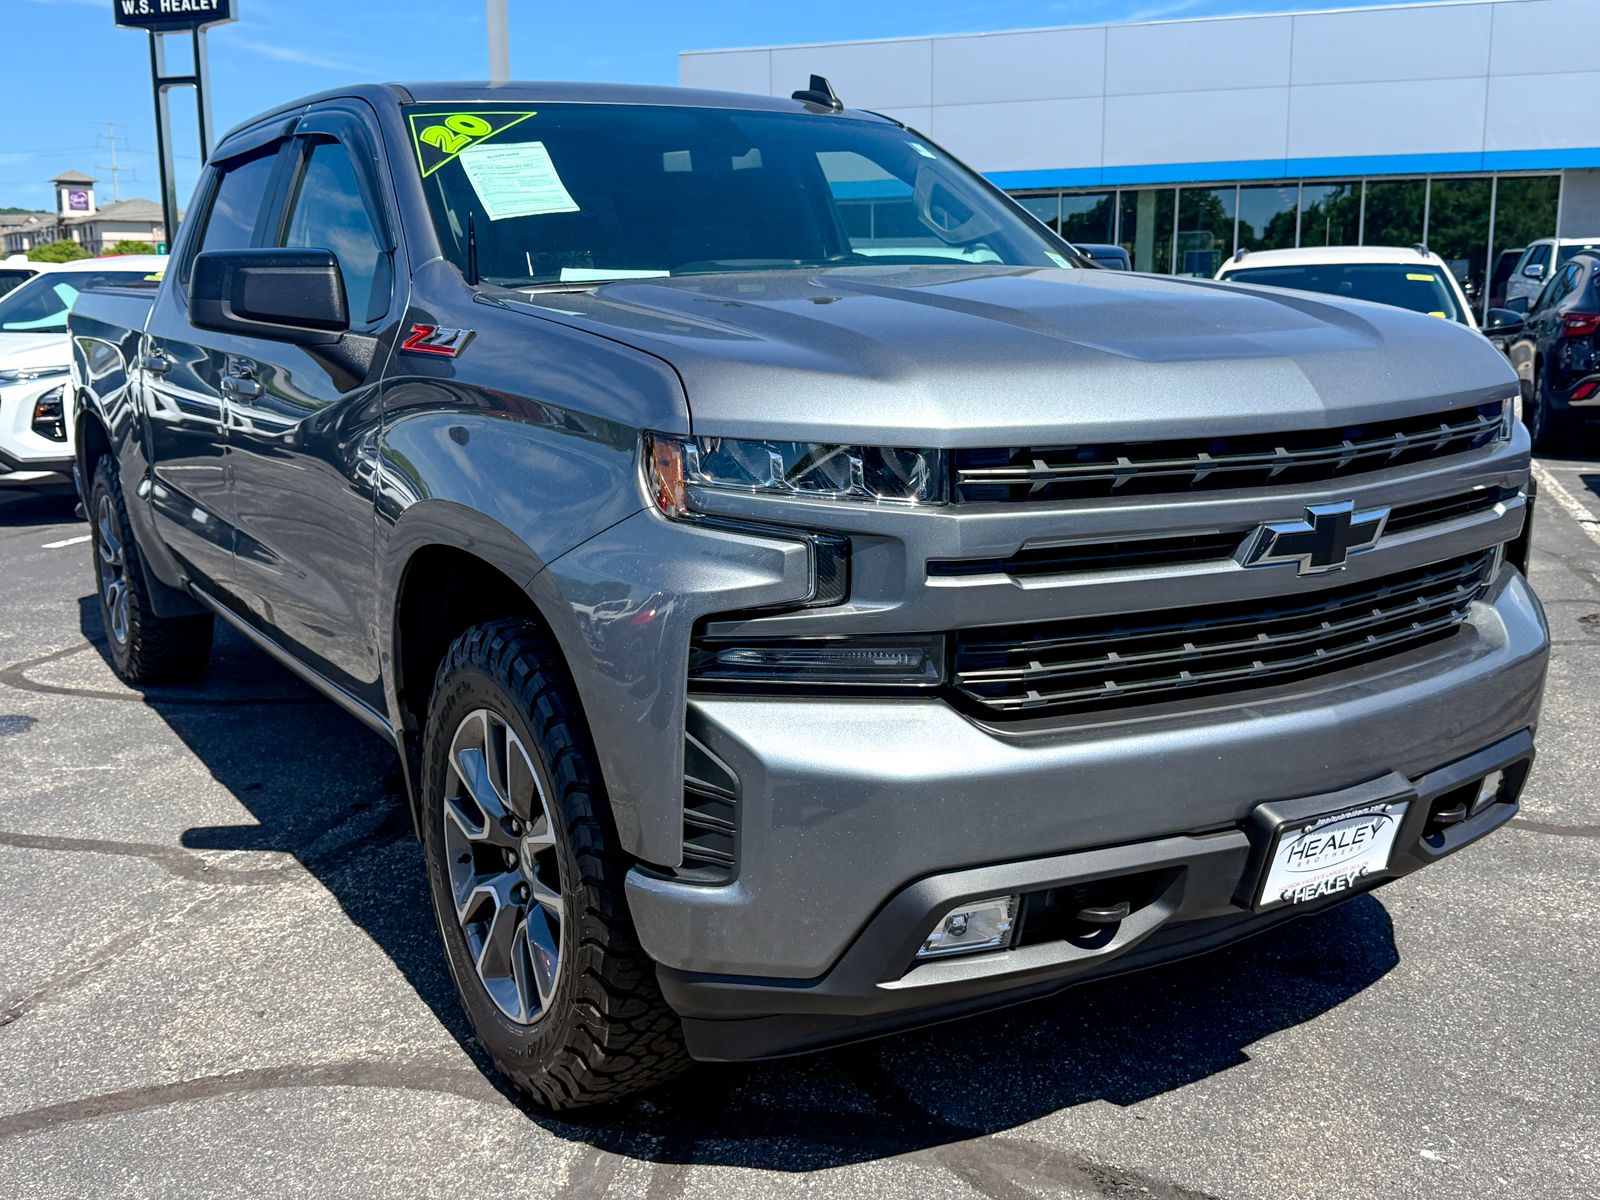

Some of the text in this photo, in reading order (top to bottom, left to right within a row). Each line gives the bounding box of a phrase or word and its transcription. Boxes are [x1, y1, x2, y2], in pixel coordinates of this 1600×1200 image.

[121, 0, 218, 15] W.S. HEALEY
[420, 114, 493, 154] 20
[401, 323, 477, 358] Z71
[1287, 821, 1387, 864] HEALEY
[1297, 844, 1363, 868] BROTHERS
[1293, 872, 1357, 905] HEALEY
